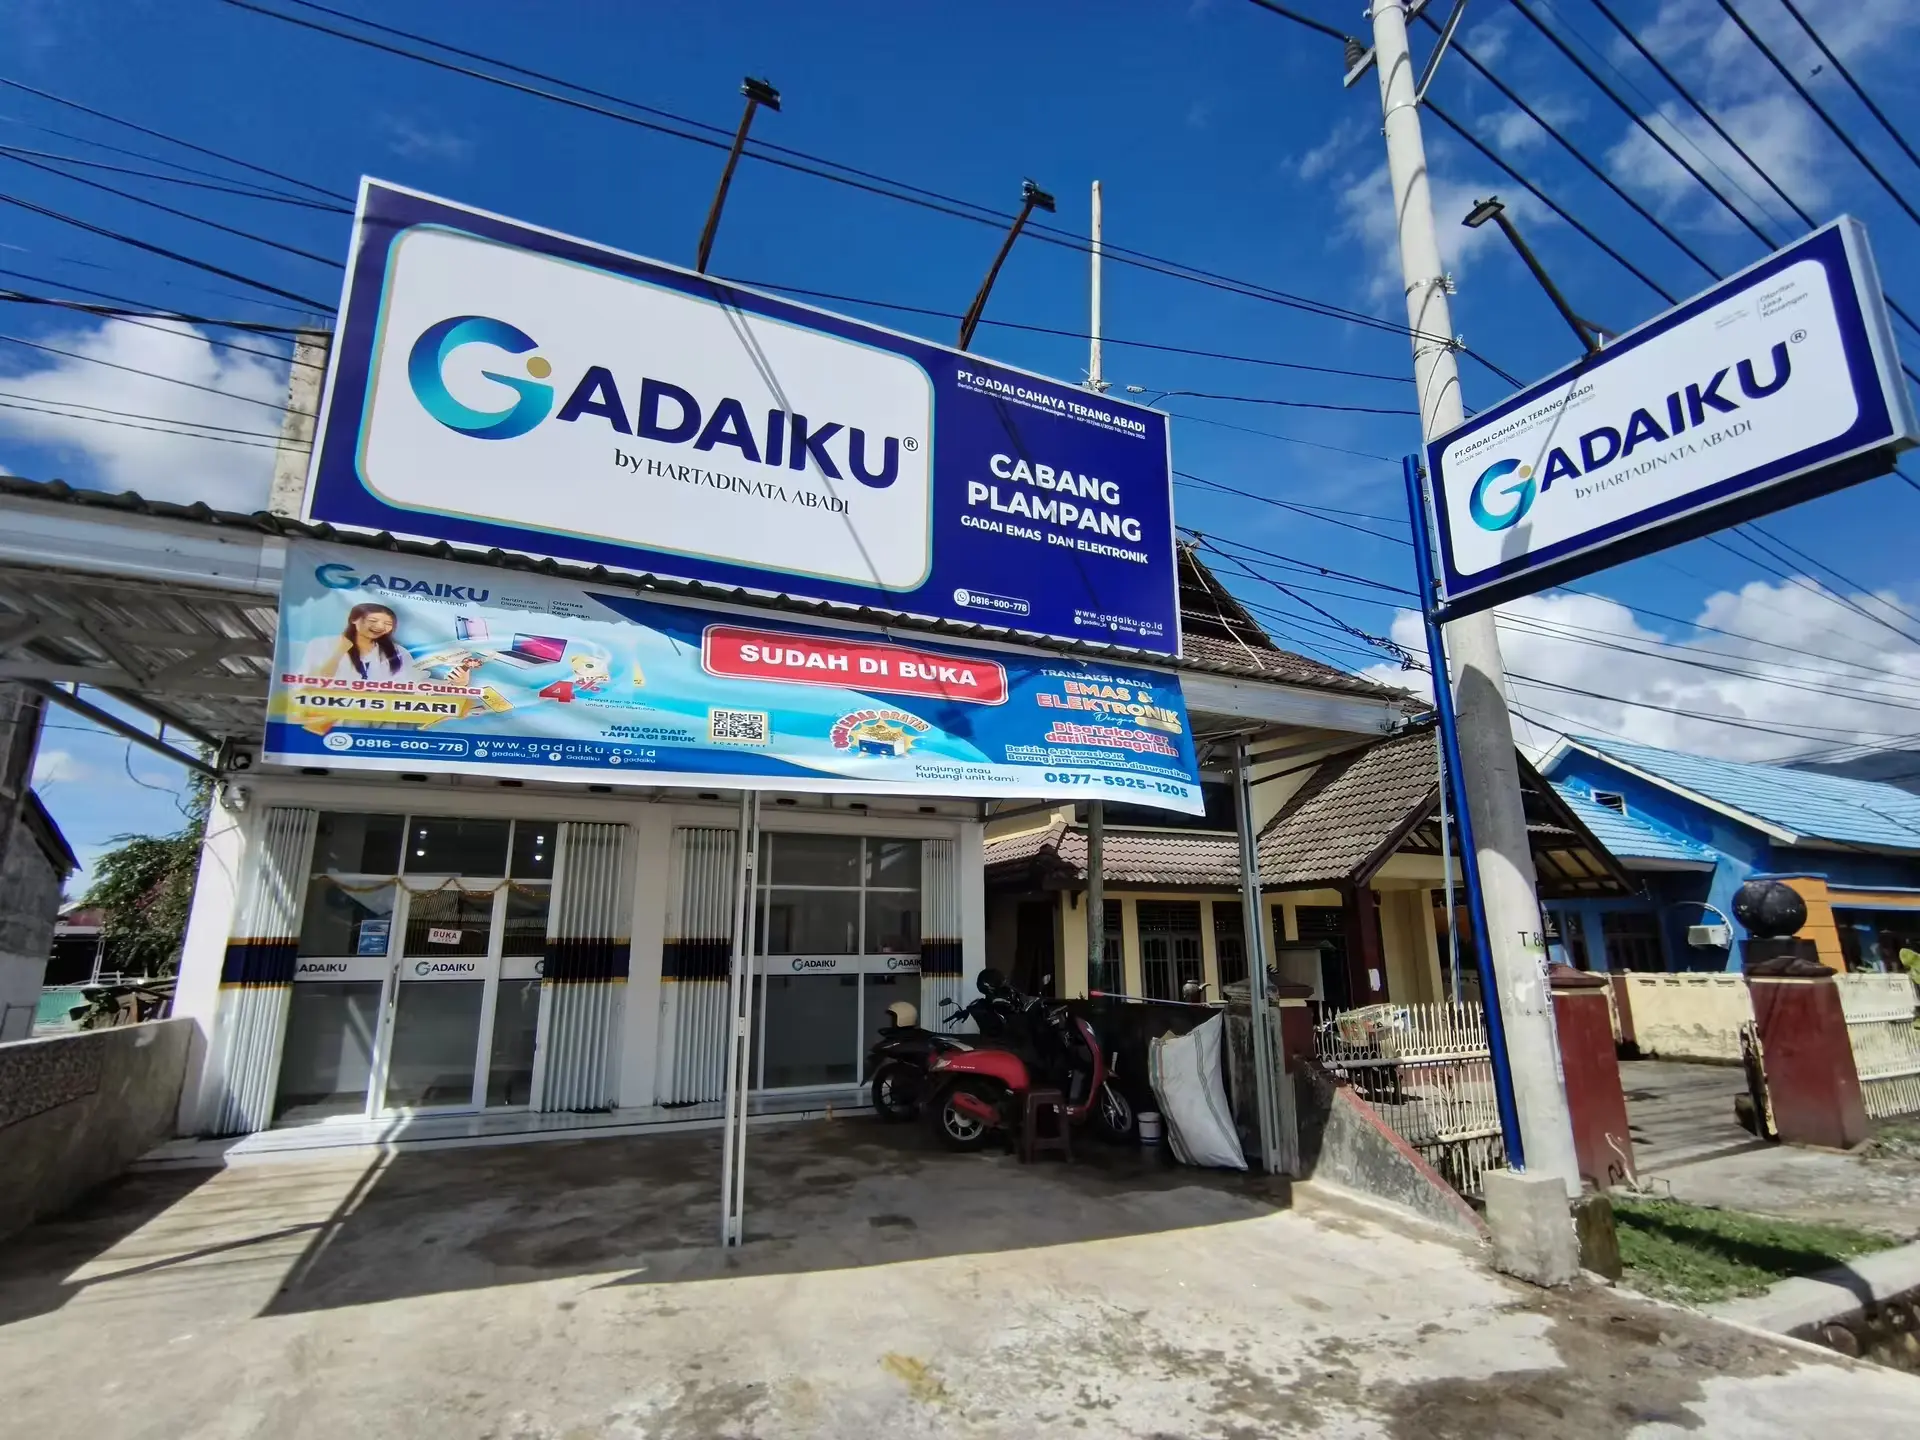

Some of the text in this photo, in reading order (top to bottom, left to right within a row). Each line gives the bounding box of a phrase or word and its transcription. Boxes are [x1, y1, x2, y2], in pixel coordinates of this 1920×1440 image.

[408, 315, 899, 489] GADAIKU
[957, 370, 1146, 433] PT.GADAI CAHAYA TERANG ABADI
[1454, 436, 1491, 459] PT.GADAI
[1491, 418, 1527, 440] CAHAYA
[1528, 400, 1563, 421] TERANG
[1564, 384, 1593, 404] ABADI
[1469, 341, 1792, 532] GADAIKU
[1575, 419, 1753, 500] by HARTADINATA ABADI
[614, 448, 850, 516] by HARTADINATA ABADI
[990, 454, 1120, 506] CABANG
[968, 480, 1142, 542] PLAMPANG
[960, 514, 1149, 564] GADAI EMAS DAN ELEKTRONIK
[315, 563, 489, 602] GADAIKU
[551, 610, 591, 619] Keuangan
[552, 600, 583, 609] Otoritas
[970, 595, 1028, 612] 0816-600-778
[1074, 609, 1163, 630] www.gadaiku.co.id
[739, 643, 978, 687] SUDAH DI BUKA
[281, 673, 481, 696] Biaya gadai Cuma
[1040, 669, 1153, 689] TRANSAKSI GADAI
[1064, 680, 1154, 703] EMAS &
[294, 695, 457, 714] 10K/15 HARI
[1037, 693, 1182, 725] ELEKTRONIK
[879, 709, 930, 732] GRATIS
[1093, 712, 1136, 726] Dengan
[600, 730, 696, 743] TAPI LAGI SIBUK
[610, 725, 688, 736] MAU GADAI?
[1053, 721, 1092, 735] Bisa
[1092, 724, 1133, 740] Take
[1134, 730, 1169, 745] Over
[355, 738, 464, 752] 0816-600-778
[477, 740, 656, 757] www.gadaiku.co.id
[1005, 744, 1049, 755] Berizin
[1059, 749, 1102, 758] Diawasi
[1104, 752, 1125, 760] OJK
[1045, 732, 1179, 758] dari lembaga lain
[491, 751, 540, 759] gadaiku_id
[566, 754, 600, 762] Gadaiku
[1007, 752, 1192, 781] Barang jaminan aman diasuransikan
[915, 765, 964, 774] Kunjungi
[916, 772, 962, 781] Hubungi
[1044, 772, 1188, 798] 0877-5925-1205
[432, 930, 458, 939] BUKA
[297, 963, 348, 973] ADAIKU
[415, 961, 475, 976] GADAIKU
[792, 958, 836, 971] GADAIKU
